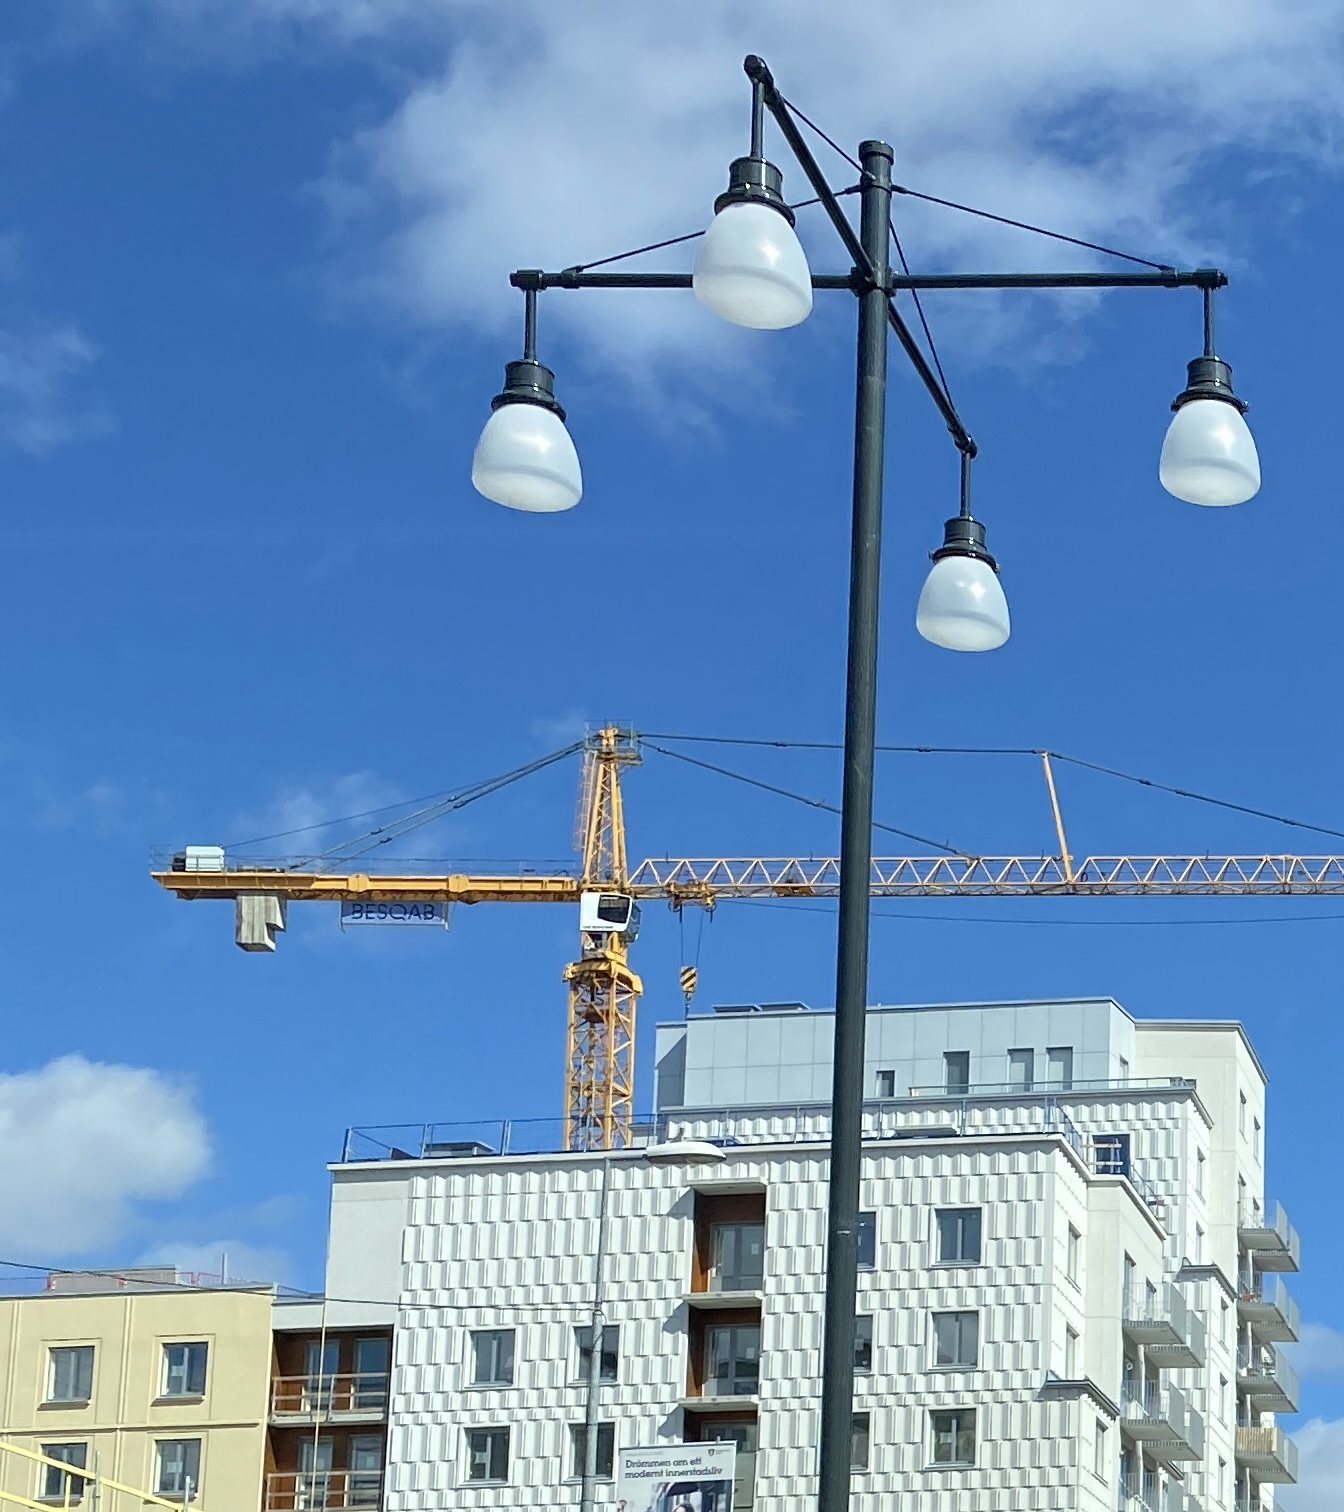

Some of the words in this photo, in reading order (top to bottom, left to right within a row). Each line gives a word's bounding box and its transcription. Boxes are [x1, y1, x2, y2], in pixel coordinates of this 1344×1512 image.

[351, 903, 435, 921] BESQAB
[626, 1459, 671, 1468] Drömmen
[690, 1457, 702, 1466] ett
[624, 1469, 664, 1479] modernt
[665, 1466, 723, 1478] innerstadsliv
